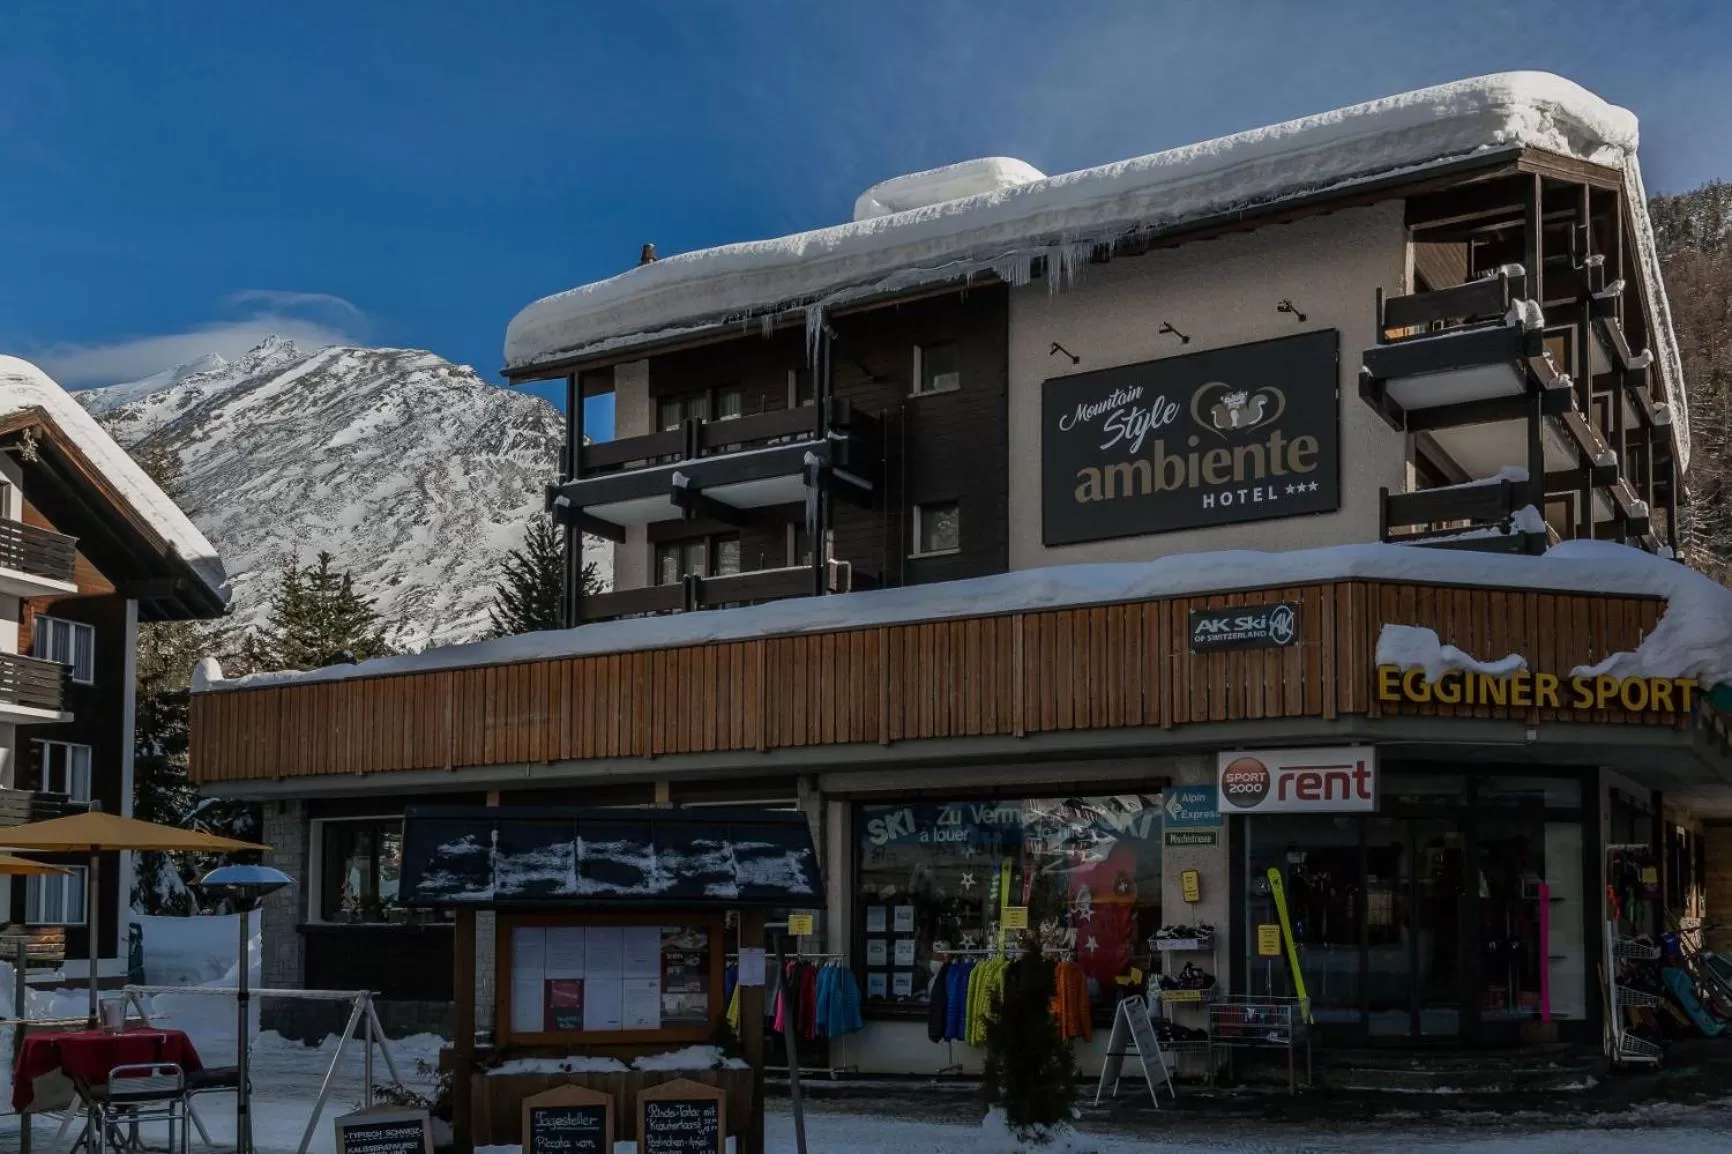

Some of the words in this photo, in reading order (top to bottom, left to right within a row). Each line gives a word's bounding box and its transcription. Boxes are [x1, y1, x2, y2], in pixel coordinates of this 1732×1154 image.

[1059, 385, 1144, 431] Mountain
[1099, 395, 1181, 454] Style
[1074, 429, 1319, 504] ambiente
[1202, 486, 1278, 509] HOTEL
[1194, 618, 1231, 634] AK
[1233, 613, 1268, 632] Ski
[1194, 634, 1206, 643] OF
[1207, 629, 1268, 642] SWITZERLAND
[1378, 664, 1559, 709] EGGINER
[1571, 675, 1697, 713] SPORT
[1226, 771, 1267, 784] SPORT
[1228, 783, 1263, 794] 2000
[1278, 760, 1371, 801] rent
[1181, 792, 1207, 803] Alpin
[867, 808, 917, 845] SKI
[936, 805, 963, 826] Zu
[933, 826, 968, 842] louer
